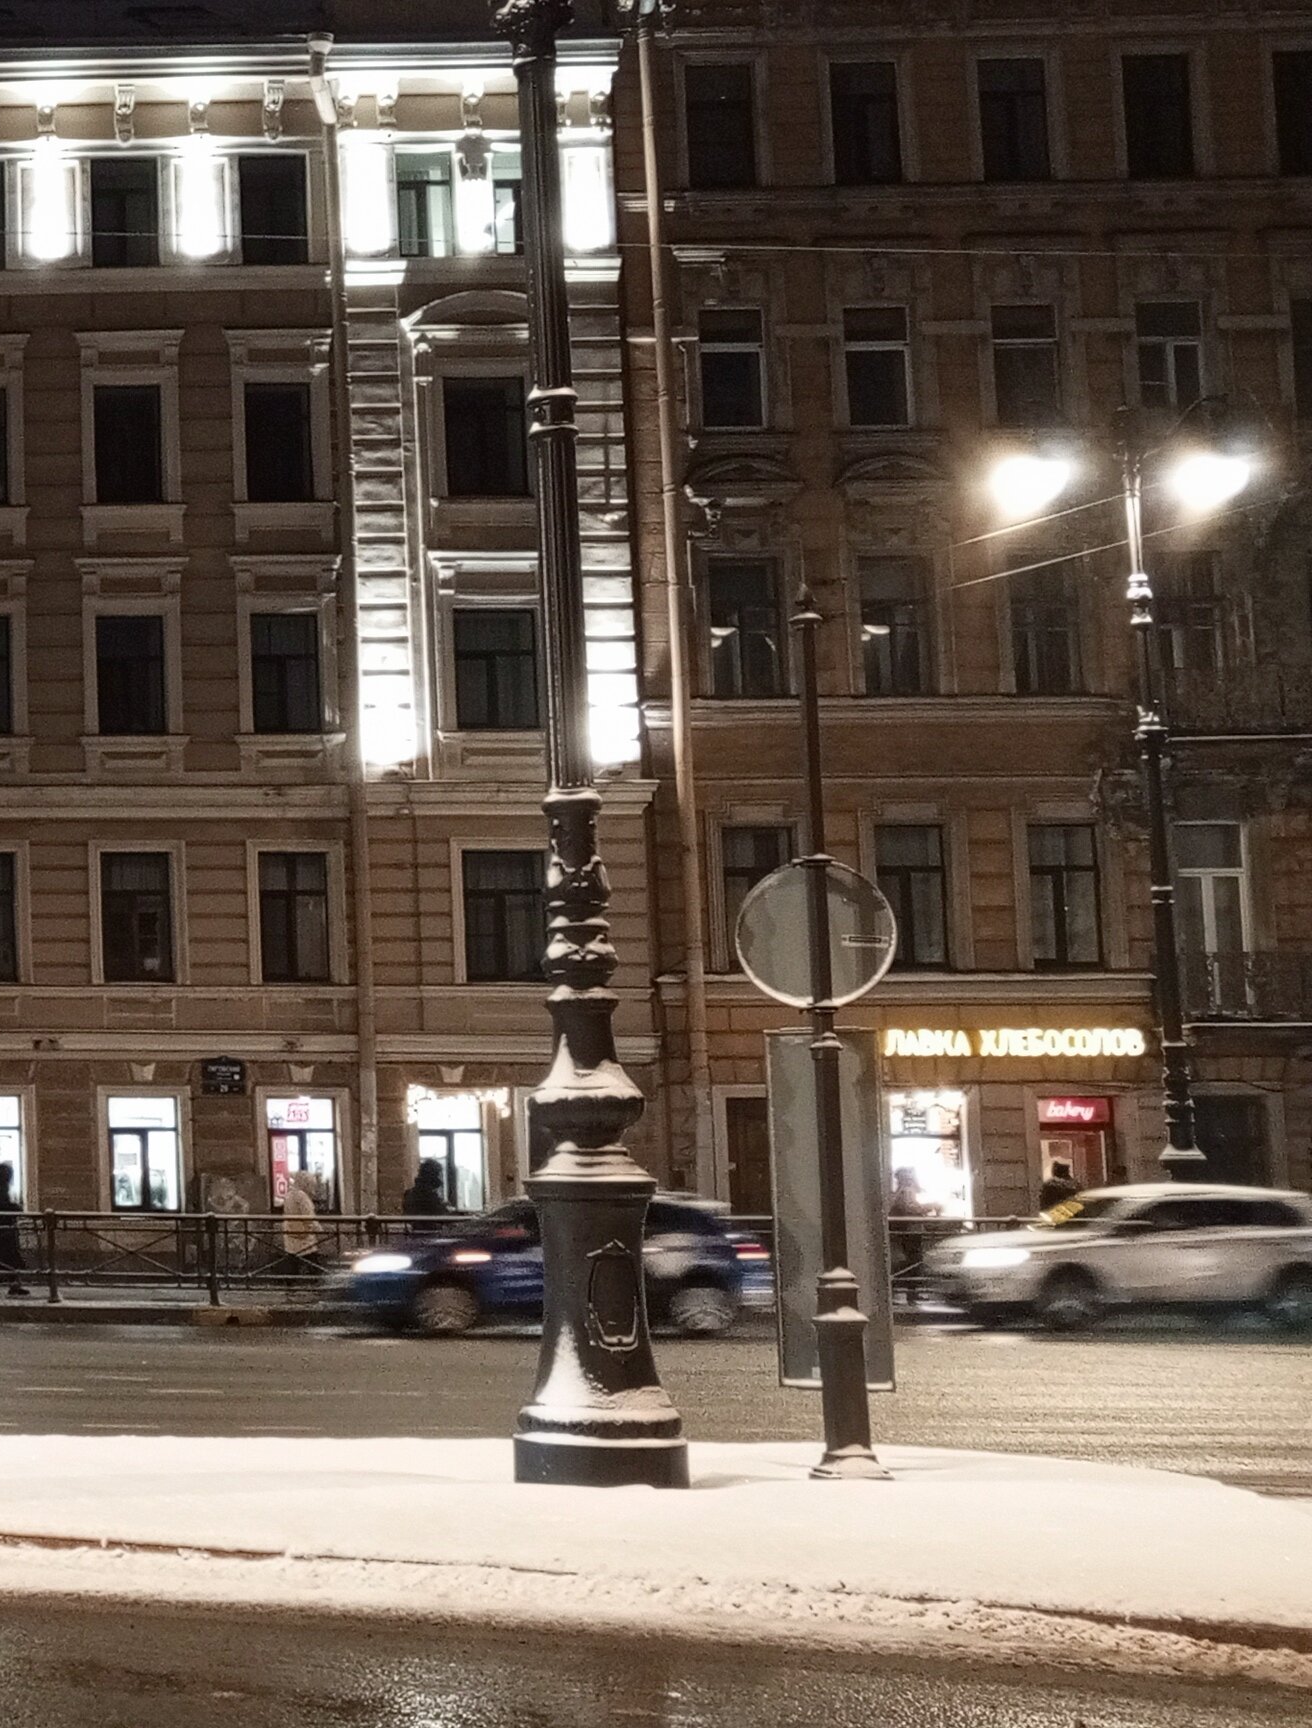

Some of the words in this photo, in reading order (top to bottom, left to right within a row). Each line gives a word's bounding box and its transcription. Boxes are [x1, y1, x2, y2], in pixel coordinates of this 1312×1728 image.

[884, 1028, 972, 1056] ЛАВКА
[979, 1028, 1146, 1057] ХЛЕБОСОЛОВ
[1046, 1101, 1095, 1121] bakery
